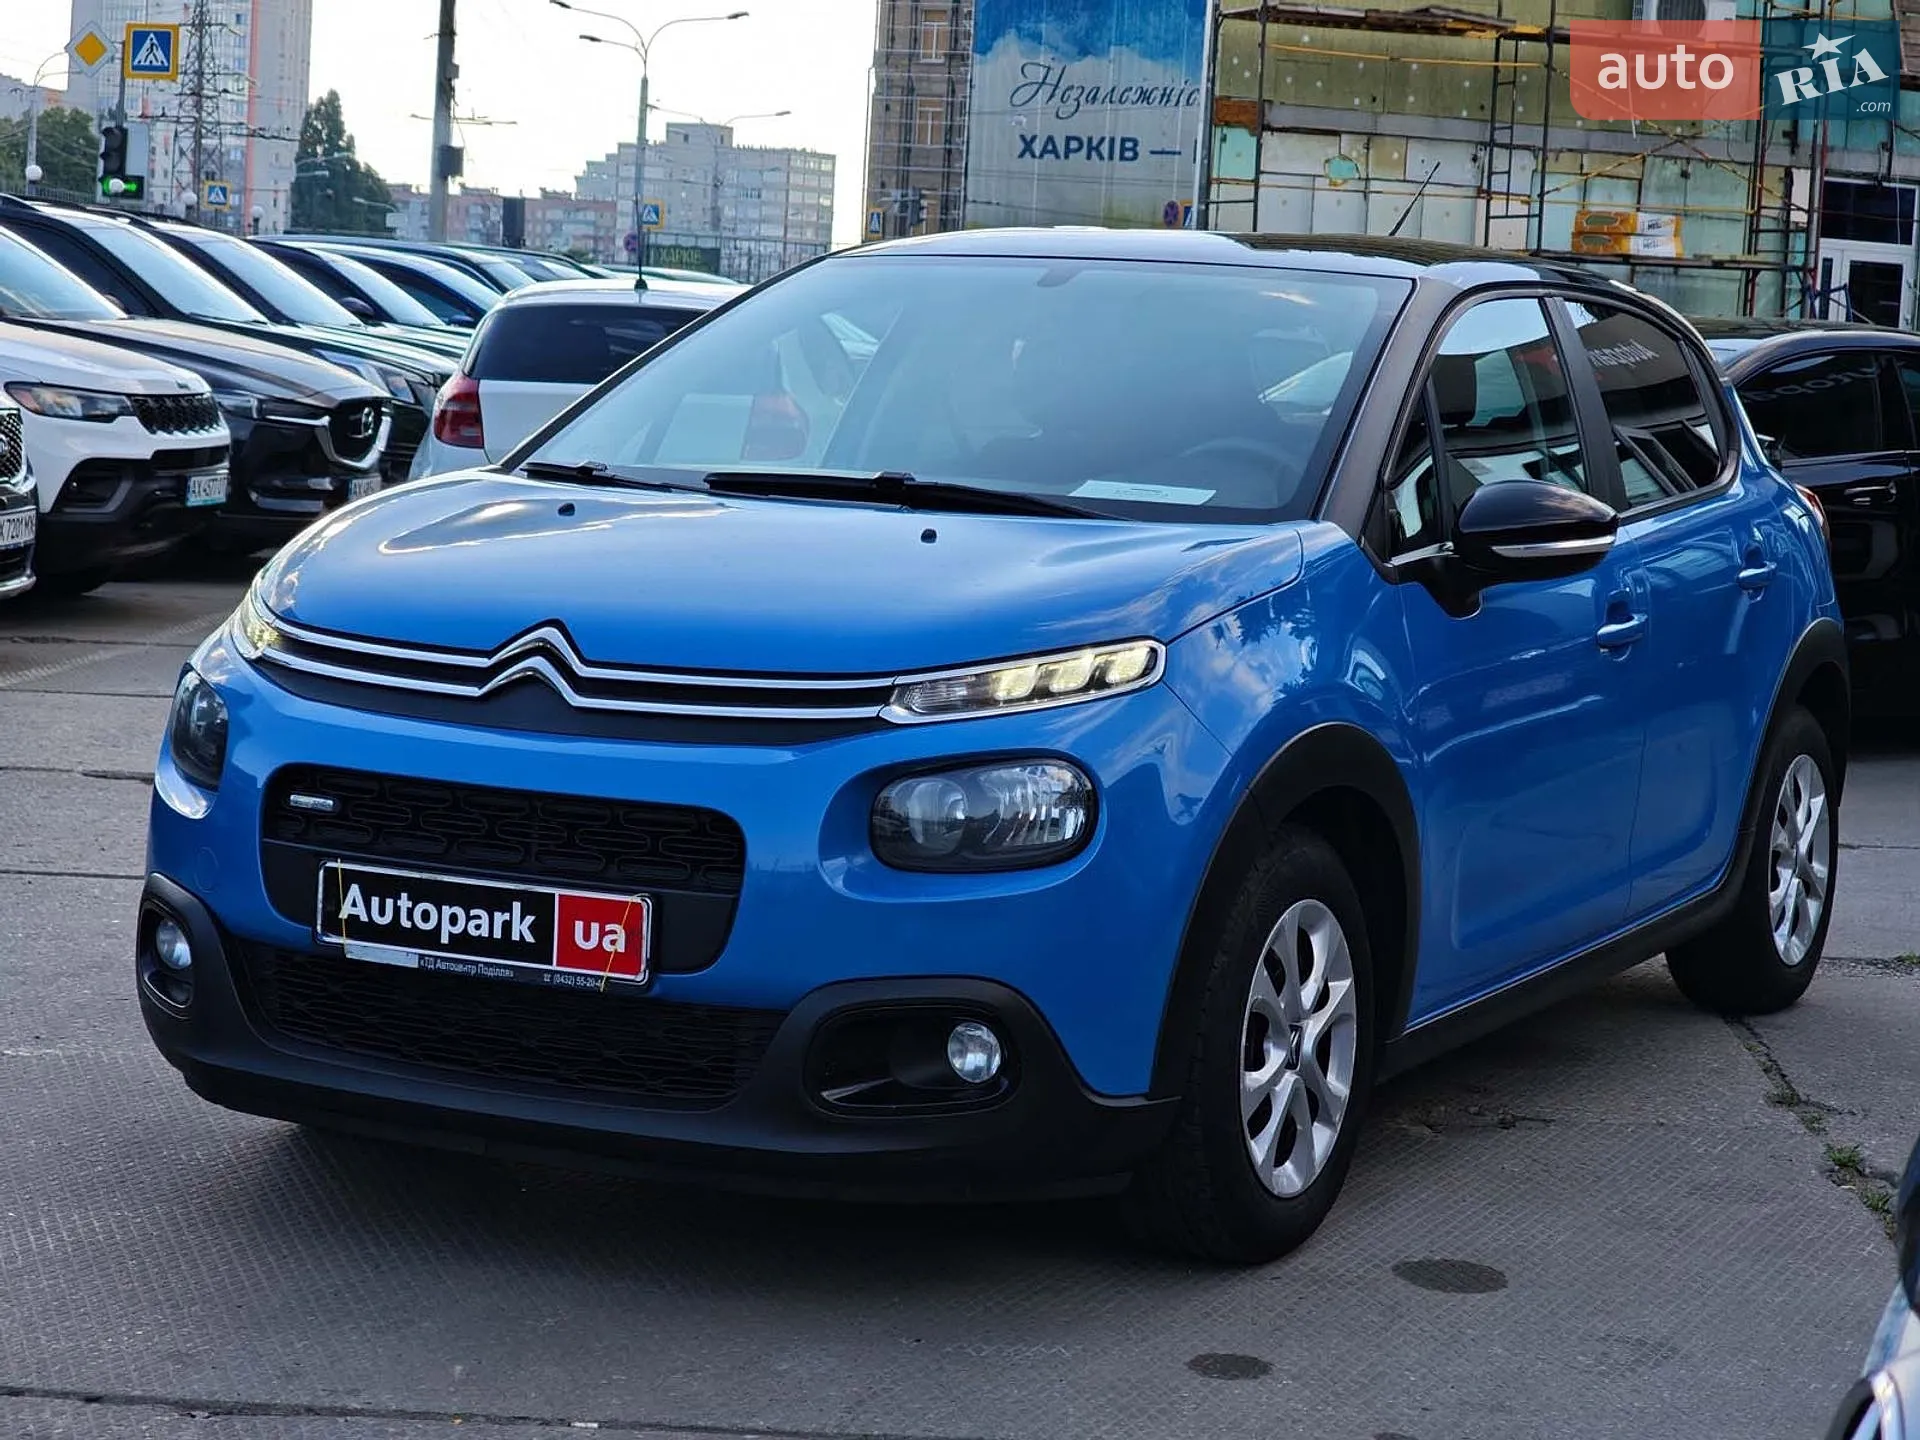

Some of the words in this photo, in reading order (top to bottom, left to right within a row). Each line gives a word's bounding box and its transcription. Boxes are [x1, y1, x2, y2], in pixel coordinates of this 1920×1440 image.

[1017, 134, 1140, 161] ХАРКІВ
[338, 883, 536, 944] Autopark
[573, 919, 626, 953] ua
